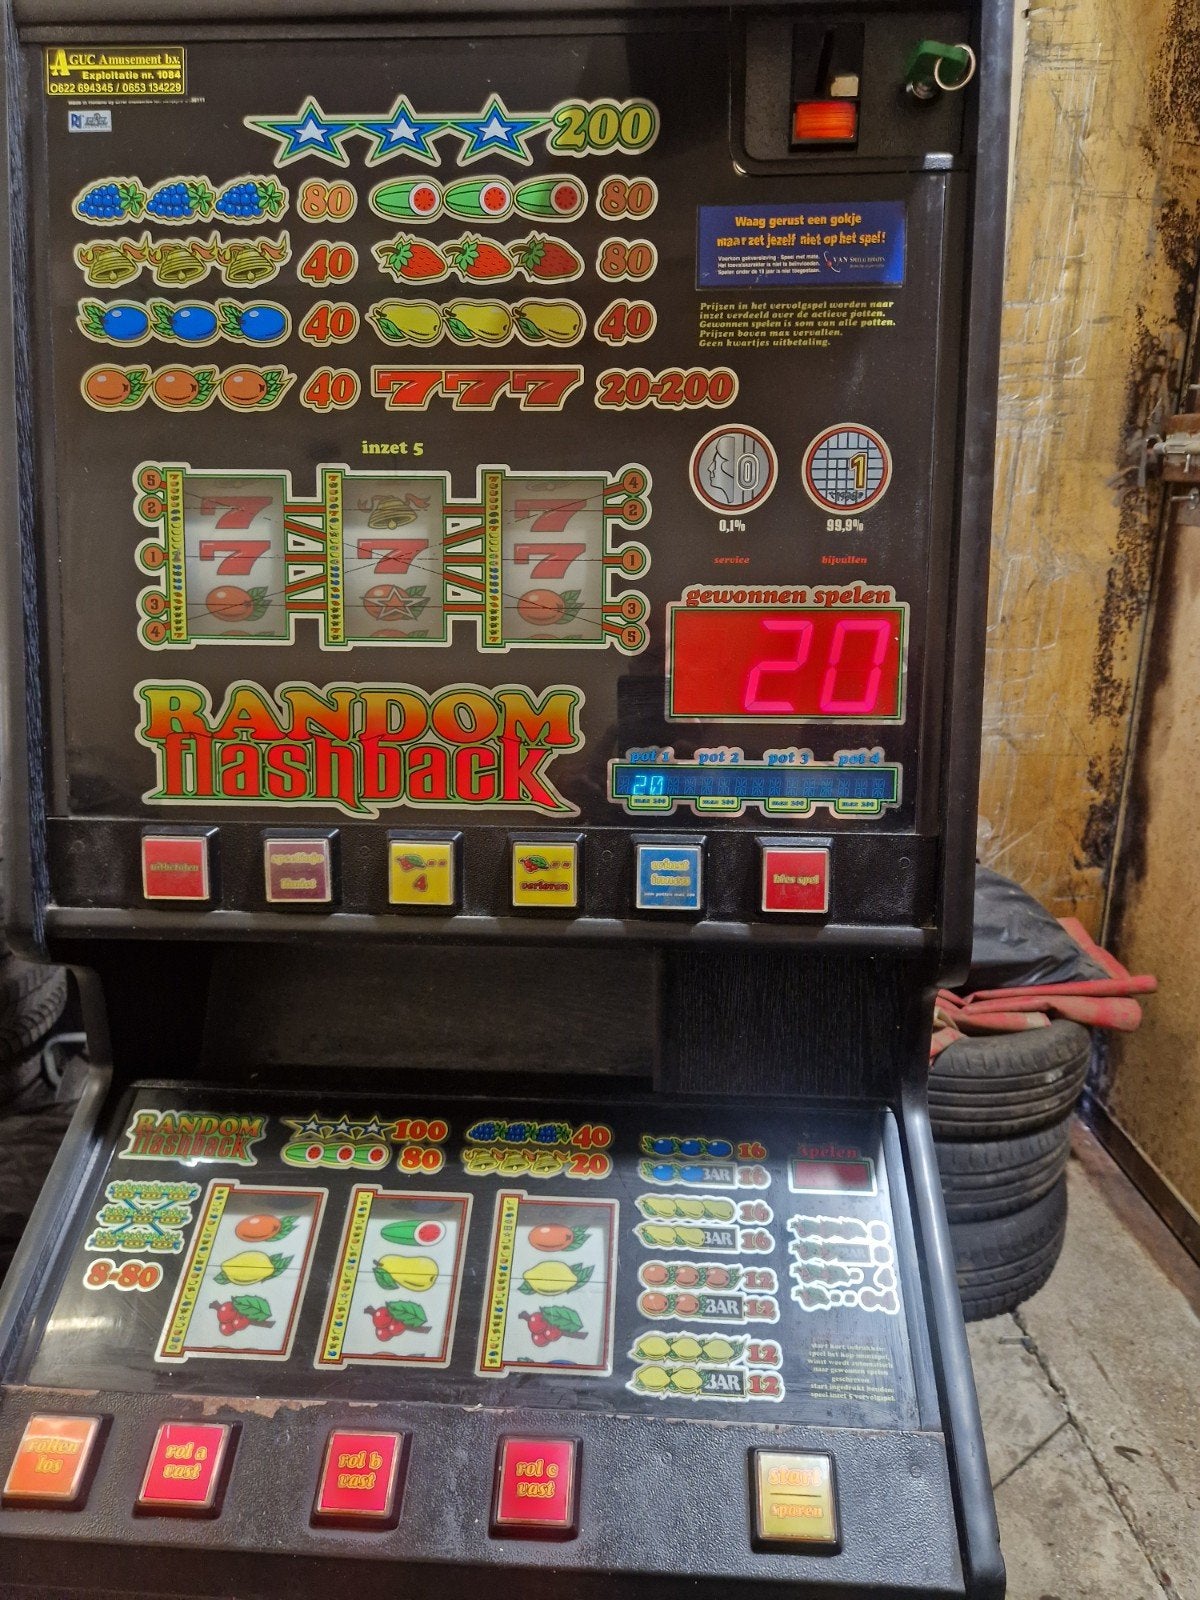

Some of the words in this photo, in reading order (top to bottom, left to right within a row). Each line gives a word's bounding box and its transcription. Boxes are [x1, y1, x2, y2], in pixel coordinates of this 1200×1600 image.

[99, 54, 161, 65] Amusement
[82, 71, 138, 81] Exploitatie
[141, 72, 154, 80] nr.
[158, 70, 181, 80] 1084
[50, 84, 76, 93] 0622
[78, 83, 113, 93] 694345
[123, 83, 146, 92] 0653
[149, 83, 182, 92] 134229
[554, 103, 655, 152] 200
[302, 181, 353, 217] 80
[597, 181, 652, 218] 80
[735, 216, 766, 228] Waag
[769, 214, 805, 228] gerust
[808, 216, 827, 225] een
[830, 213, 862, 225] gokje
[717, 236, 747, 247] maar
[748, 235, 765, 246] zet
[766, 234, 796, 248] jezelf
[800, 233, 821, 245] niet
[823, 235, 838, 246] op
[839, 232, 857, 244] het
[859, 231, 886, 246] spel!
[302, 245, 354, 281] 40
[597, 244, 652, 279] 80
[699, 311, 724, 320] inzet
[727, 311, 770, 320] verdeeld
[797, 311, 808, 319] de
[812, 310, 848, 318] actieve
[850, 309, 886, 319] potten.
[700, 302, 735, 311] Prijzen
[738, 302, 748, 310] in
[751, 301, 767, 310] het
[770, 301, 827, 311] vervolgspel
[829, 300, 867, 309] worden
[302, 305, 354, 341] 40
[598, 304, 653, 341] 40
[699, 320, 749, 329] Gewonnen
[751, 319, 781, 329] spelen
[783, 319, 792, 328] is
[794, 320, 814, 328] som
[817, 320, 836, 328] van
[838, 318, 858, 327] alle
[860, 318, 896, 328] potten.
[699, 329, 735, 338] Prijzen
[737, 329, 766, 338] boven
[793, 328, 843, 337] vervallen.
[699, 339, 723, 347] Geen
[726, 338, 770, 348] kwartjes
[772, 338, 831, 348] uitbetaling.
[305, 371, 355, 407] 40
[600, 371, 735, 407] 20-200
[361, 440, 408, 455] inzet
[413, 442, 424, 456] 5
[719, 519, 745, 532] 0,1%
[826, 519, 864, 532] 99,9%
[713, 556, 750, 564] service
[821, 555, 868, 566] bijvullen
[686, 588, 807, 608] gewonnen
[813, 585, 891, 608] spelen
[744, 619, 891, 712] 20
[142, 686, 580, 746] RANDOM
[630, 750, 659, 764] pot
[662, 750, 669, 763] 1
[699, 752, 728, 765] pot
[730, 752, 739, 764] 2
[768, 753, 797, 766] pot
[800, 753, 809, 764] 3
[838, 754, 867, 767] pot
[870, 752, 880, 765] 4
[152, 733, 576, 813] flashback
[633, 775, 664, 795] 20
[413, 874, 427, 891] 4
[135, 1113, 264, 1138] RANDOM
[390, 1119, 448, 1143] 100
[572, 1126, 611, 1149] 40
[400, 1147, 442, 1170] 80
[737, 1142, 767, 1160] 16
[568, 1154, 609, 1175] 20
[86, 1262, 160, 1289] 8-80
[749, 1344, 778, 1364] 12
[749, 1374, 780, 1394] 12
[165, 1442, 192, 1460] rol
[194, 1446, 208, 1461] a
[337, 1451, 366, 1468] rol
[369, 1451, 383, 1470] b
[36, 1455, 63, 1474] los
[163, 1462, 201, 1480] vast
[515, 1459, 543, 1477] rol
[546, 1463, 559, 1478] c
[337, 1471, 376, 1490] vast
[768, 1465, 822, 1487] start
[516, 1479, 556, 1499] vast
